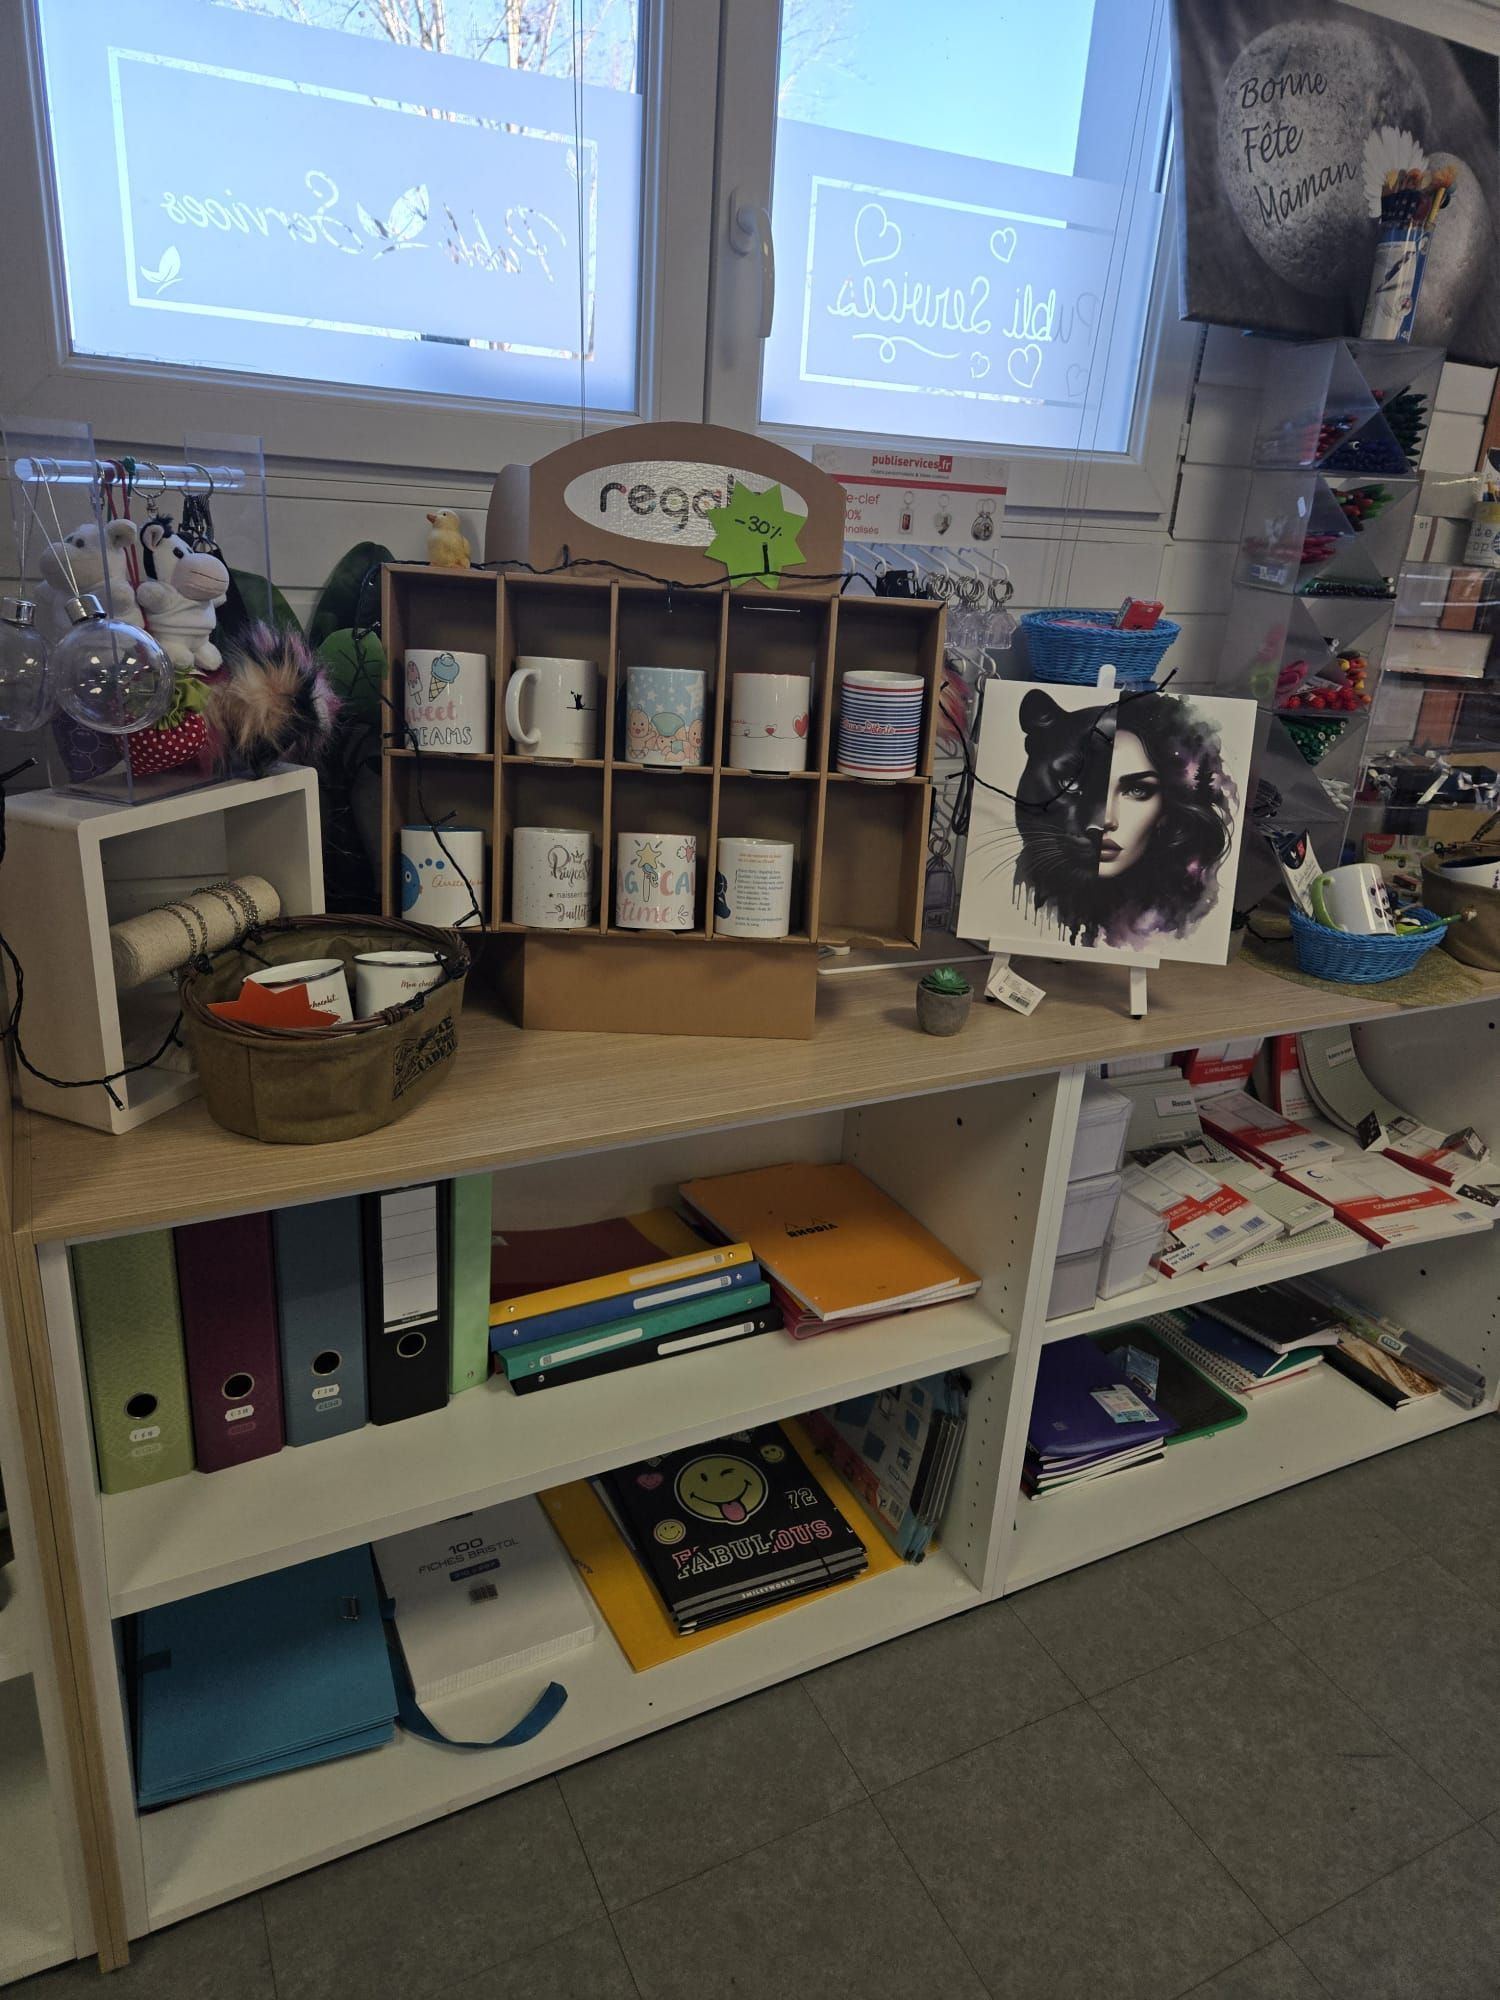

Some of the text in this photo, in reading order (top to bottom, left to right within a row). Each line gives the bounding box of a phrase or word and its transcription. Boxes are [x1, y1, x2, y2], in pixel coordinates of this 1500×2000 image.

[1239, 70, 1328, 110] Bonne
[1241, 122, 1304, 173] Fête
[1254, 159, 1357, 228] Maman
[872, 454, 952, 472] publiservices.fr
[846, 493, 880, 505] e-clef
[735, 515, 783, 539] -30%
[844, 525, 879, 535] nnalisés
[407, 727, 473, 746] EAMS
[620, 899, 672, 924] time
[310, 994, 338, 1009] hocolat
[786, 1223, 839, 1238] RHODIA
[784, 1488, 819, 1509] 72
[418, 1537, 520, 1574] FICHES BRISTOL
[448, 1537, 483, 1554] 100
[671, 1519, 833, 1581] FABULOUS
[741, 1578, 797, 1600] SMILEYWORLD
